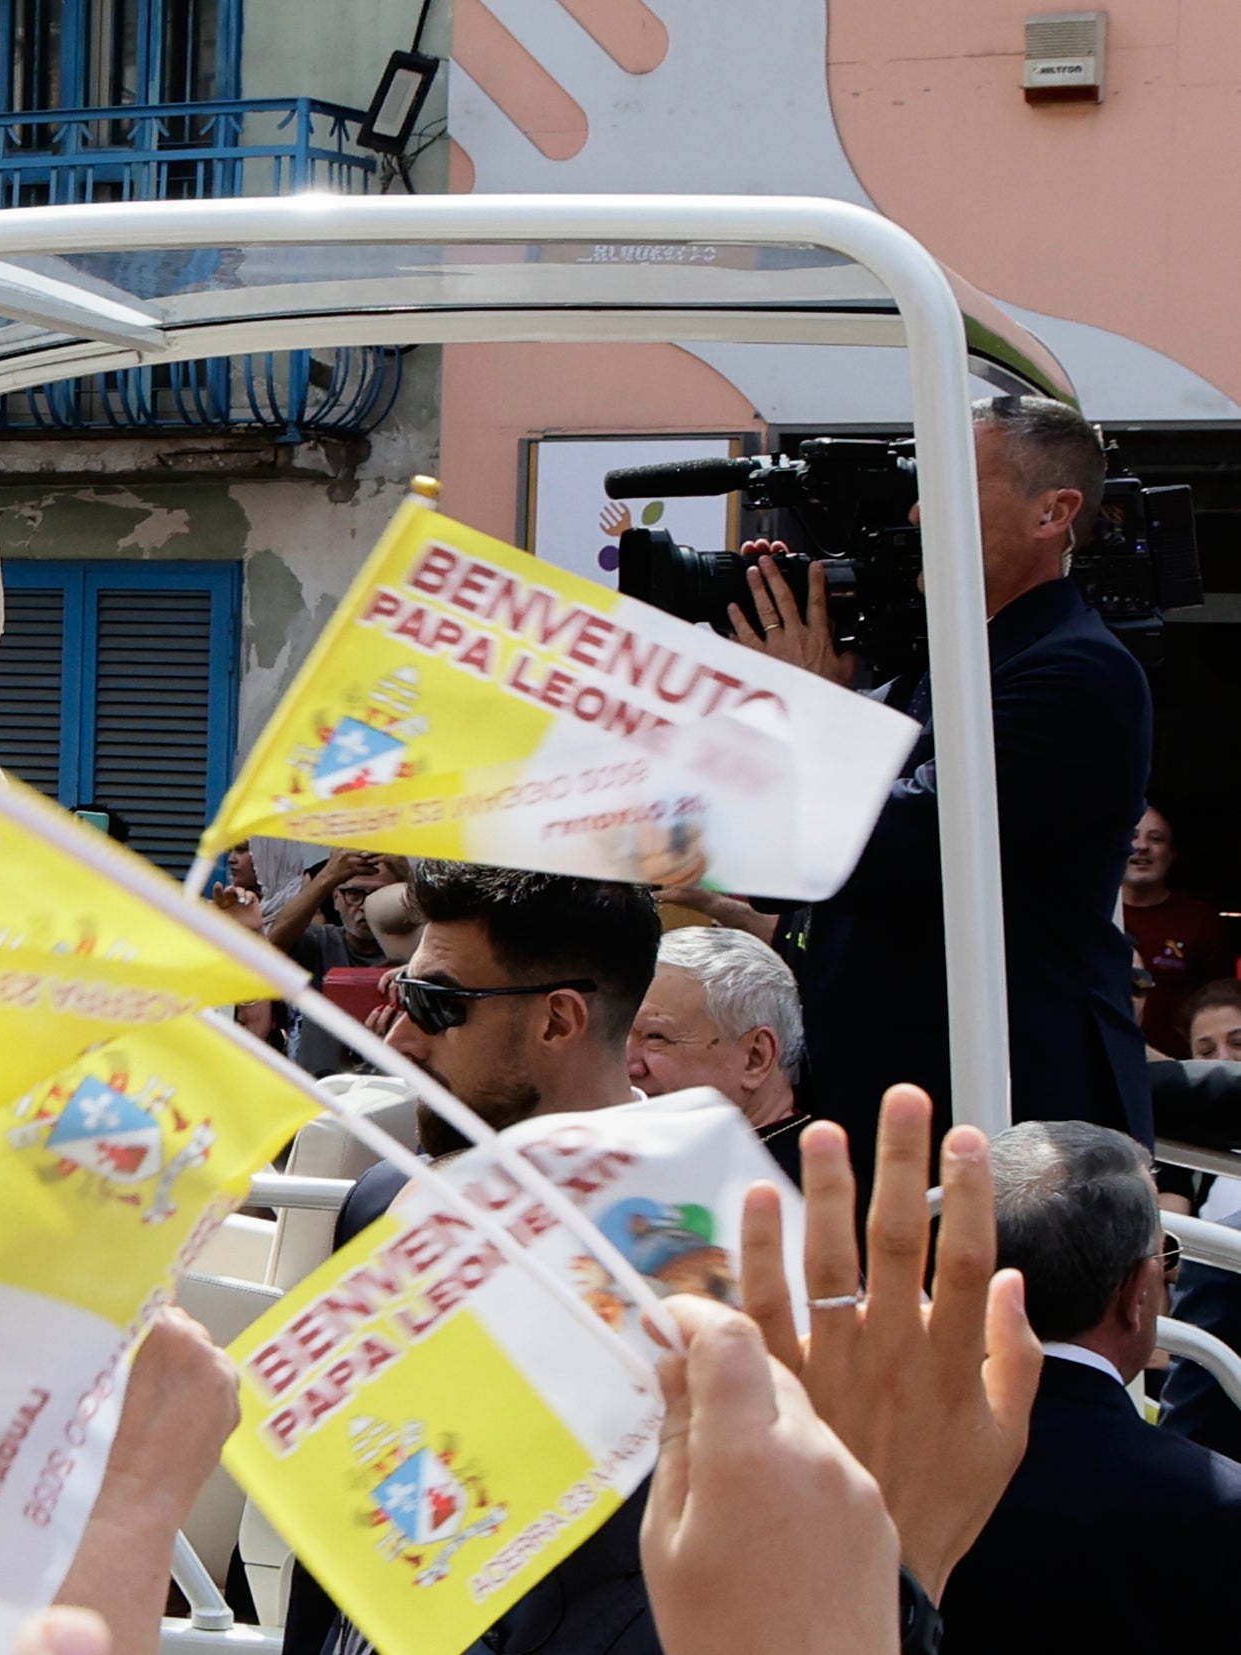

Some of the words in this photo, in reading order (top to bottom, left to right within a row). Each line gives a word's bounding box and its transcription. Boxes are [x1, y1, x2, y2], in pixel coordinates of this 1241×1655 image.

[362, 590, 494, 674] PAPA
[250, 1125, 592, 1397] BENVENUTO
[266, 1336, 399, 1451] PAPA
